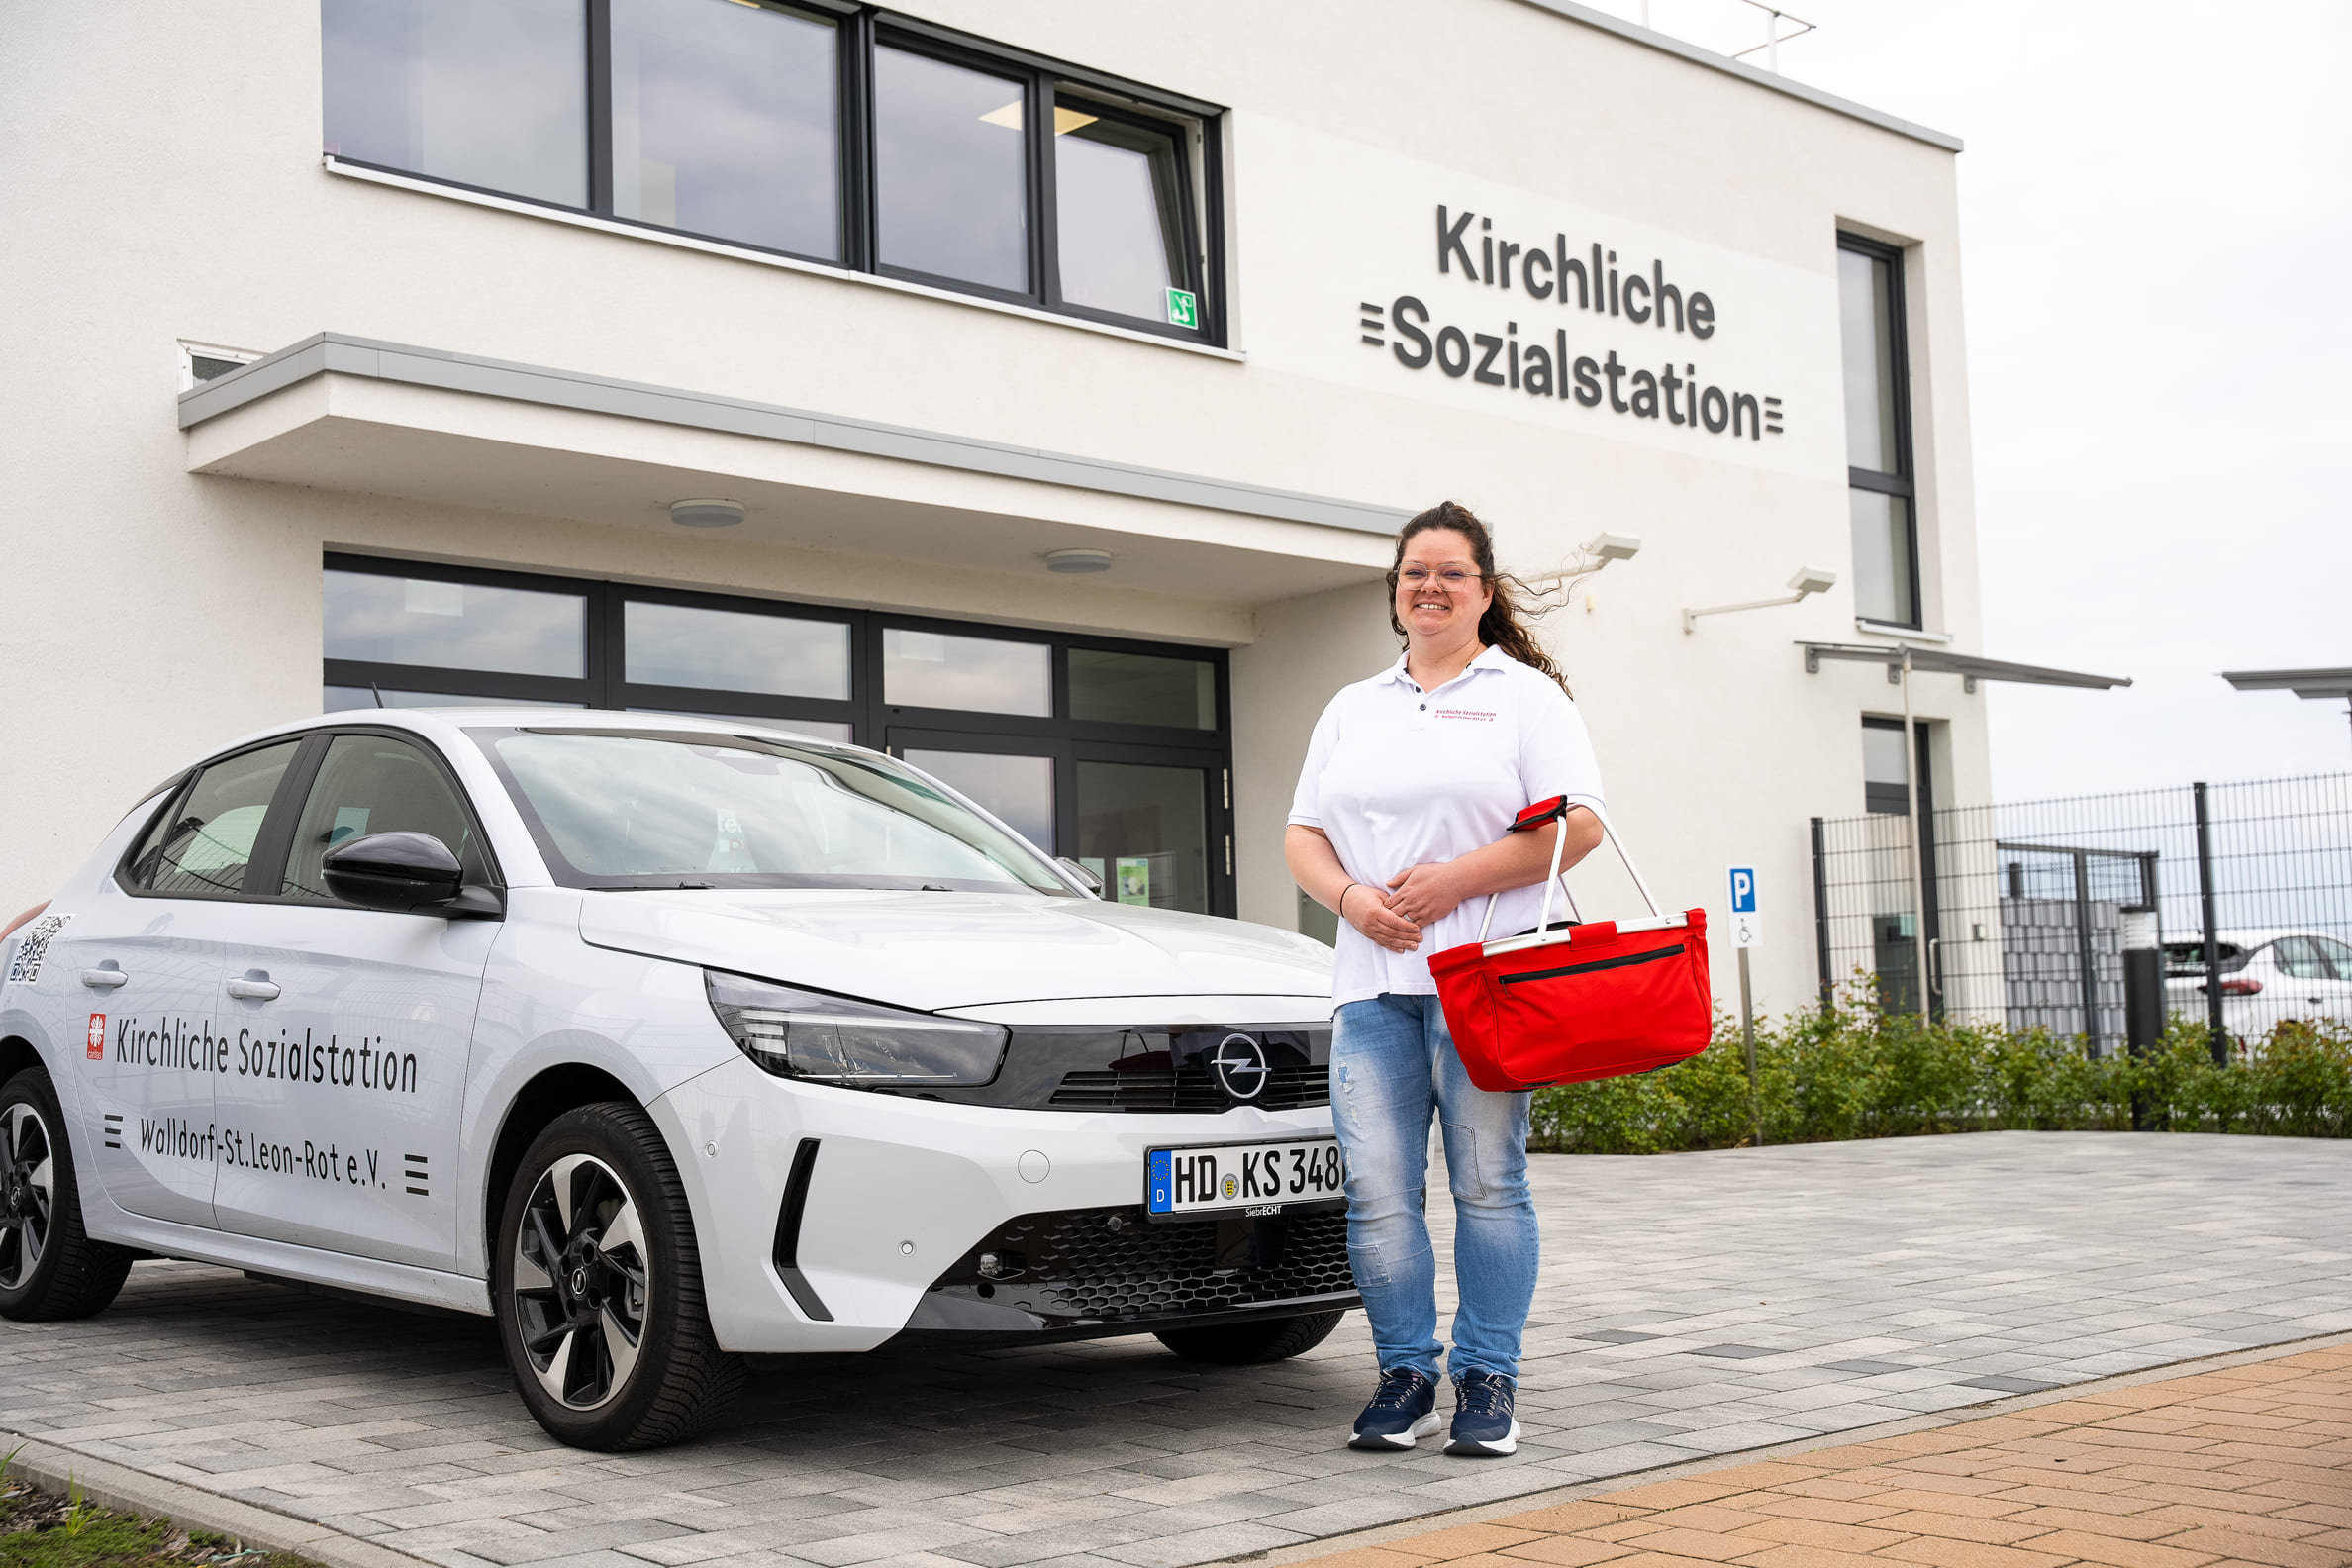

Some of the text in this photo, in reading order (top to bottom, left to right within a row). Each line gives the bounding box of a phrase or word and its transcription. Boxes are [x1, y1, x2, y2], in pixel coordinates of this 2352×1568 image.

[1437, 204, 1715, 340] Kirchliche
[1391, 295, 1760, 441] Sozialstation
[1733, 872, 1751, 909] P
[116, 1016, 417, 1093] Kirchliche Sozialstation
[141, 1118, 387, 1190] Walldorf-St.Leon-Rot e.V.
[1175, 1155, 1217, 1203] HD
[1242, 1150, 1280, 1198] KS
[1156, 1189, 1165, 1203] D
[1245, 1205, 1282, 1218] SiebrECHT
